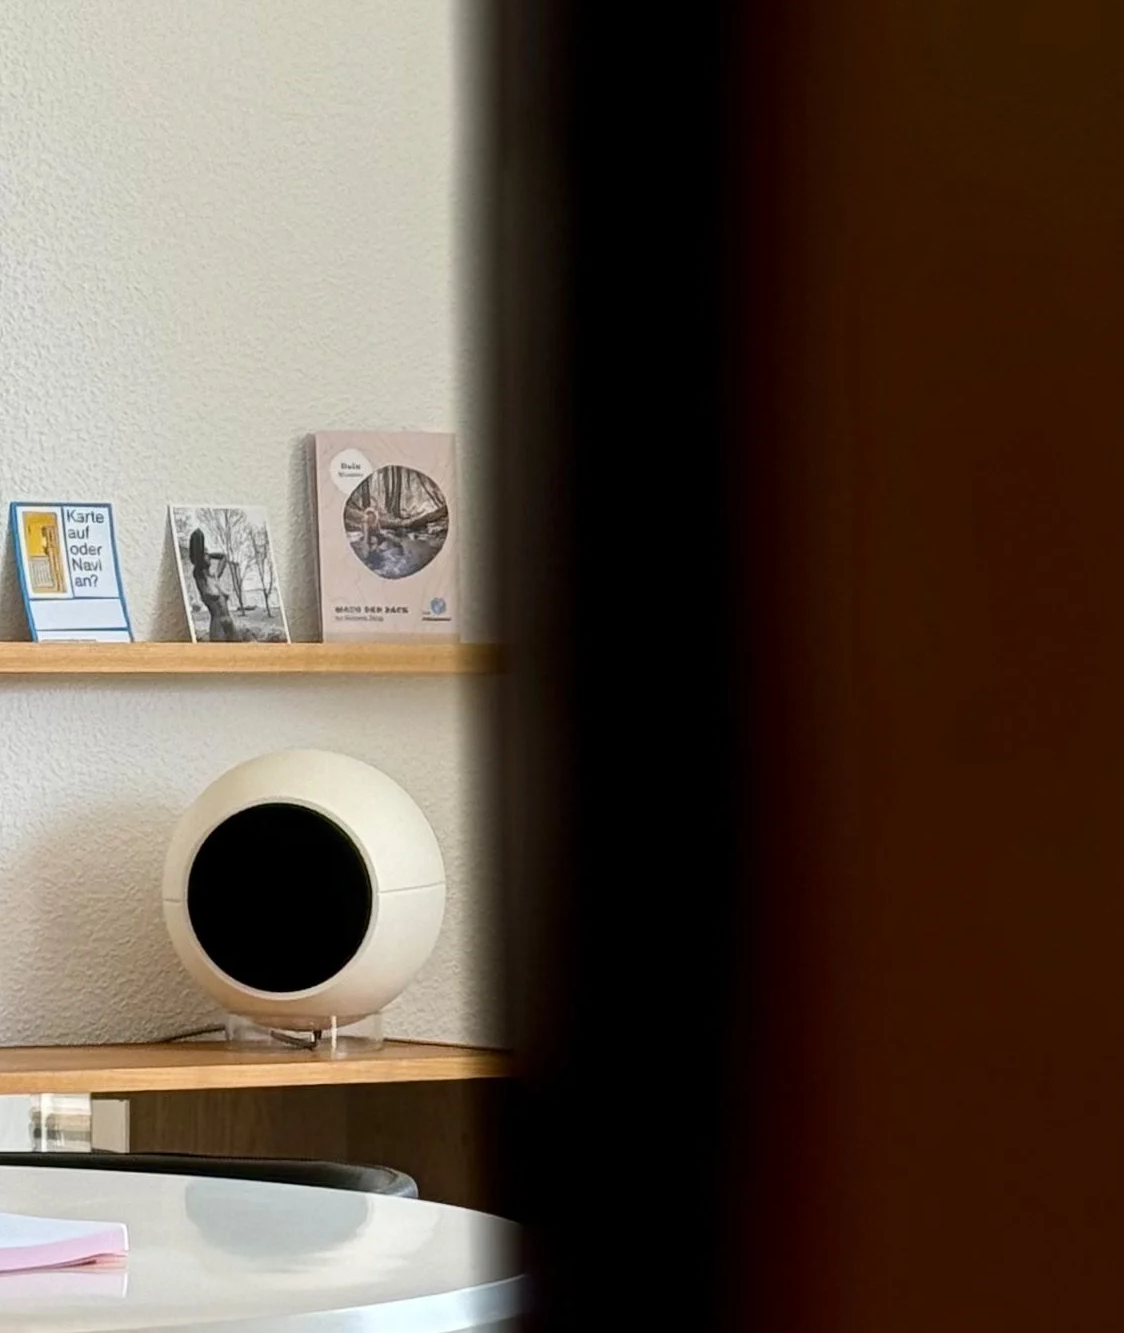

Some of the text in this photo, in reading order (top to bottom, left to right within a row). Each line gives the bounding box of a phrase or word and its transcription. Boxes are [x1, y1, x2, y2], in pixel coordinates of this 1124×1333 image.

[66, 509, 104, 523] Karte
[68, 525, 90, 539] auf
[70, 544, 102, 556] oder
[72, 558, 102, 571] Navi
[75, 574, 98, 588] an?
